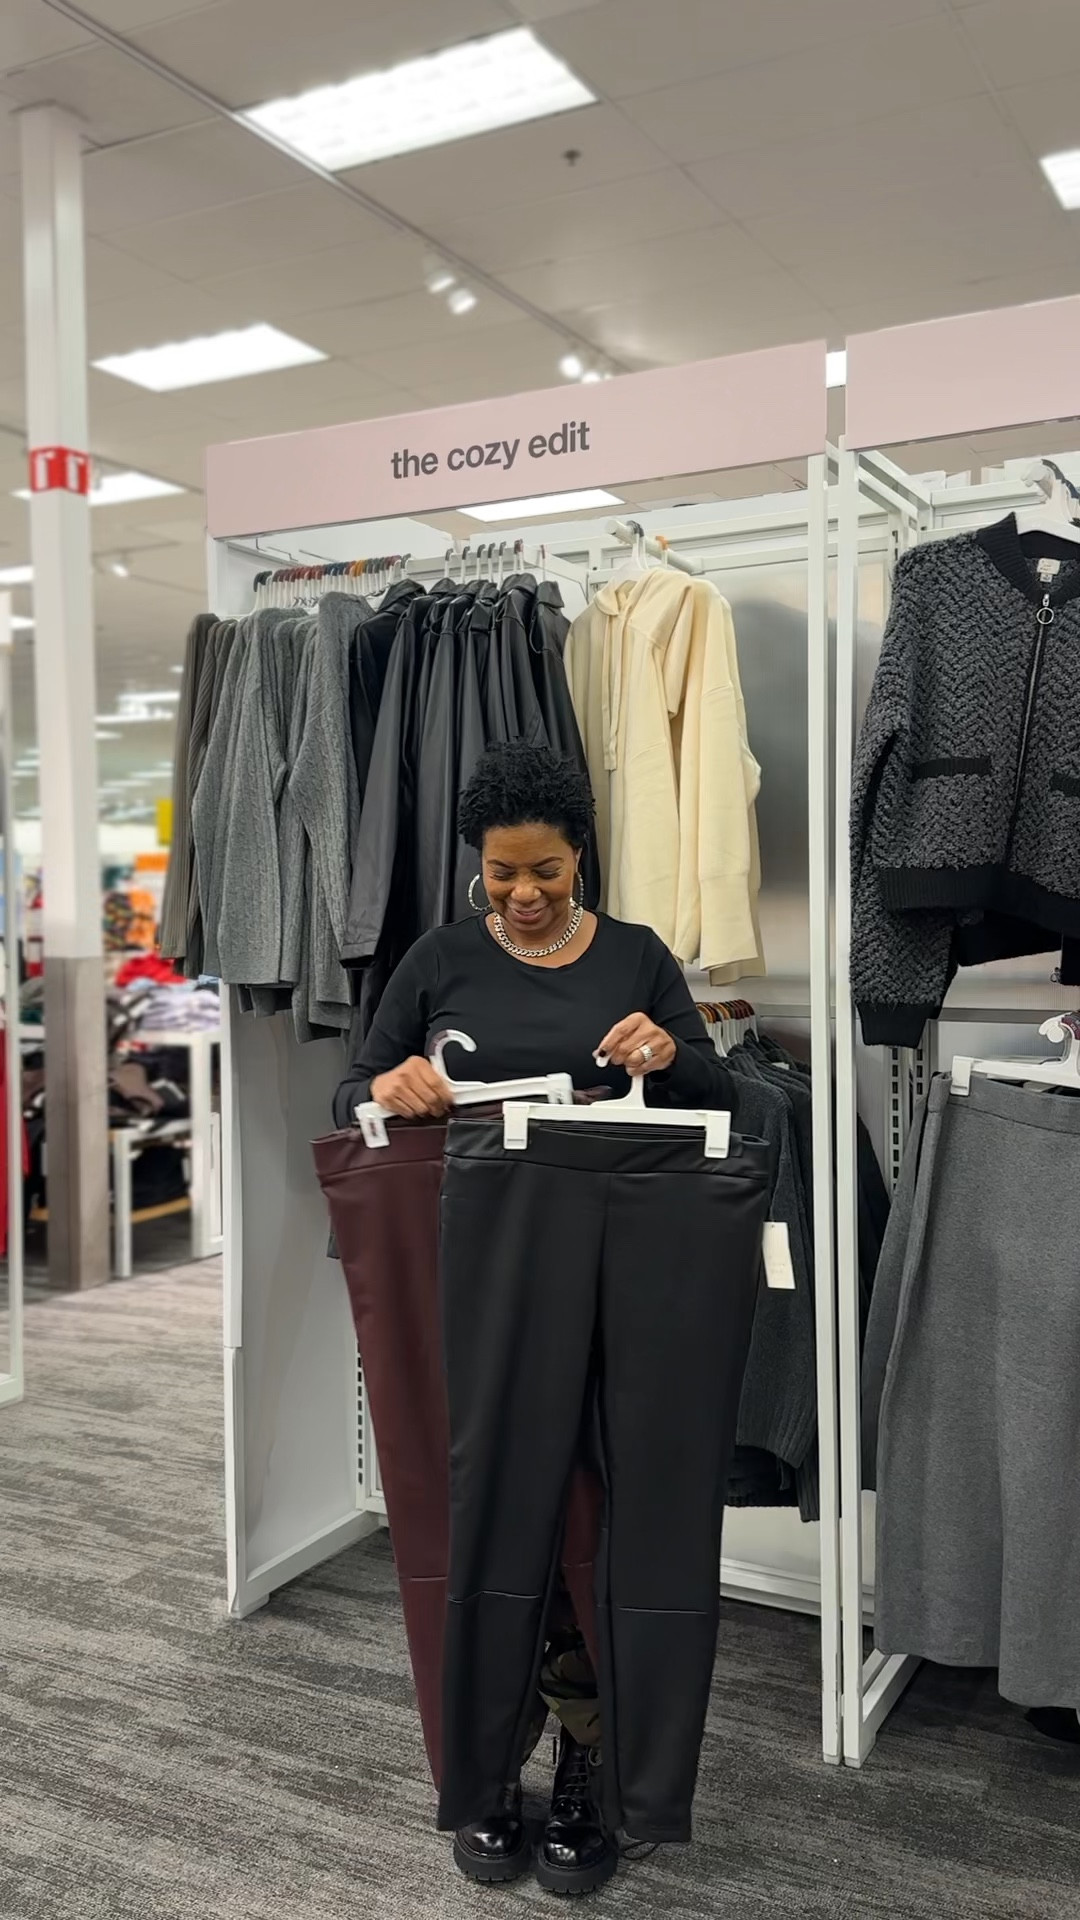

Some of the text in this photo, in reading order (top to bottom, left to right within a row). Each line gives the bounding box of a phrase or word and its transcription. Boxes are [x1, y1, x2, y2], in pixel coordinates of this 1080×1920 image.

[391, 421, 590, 479] the cozy edit
